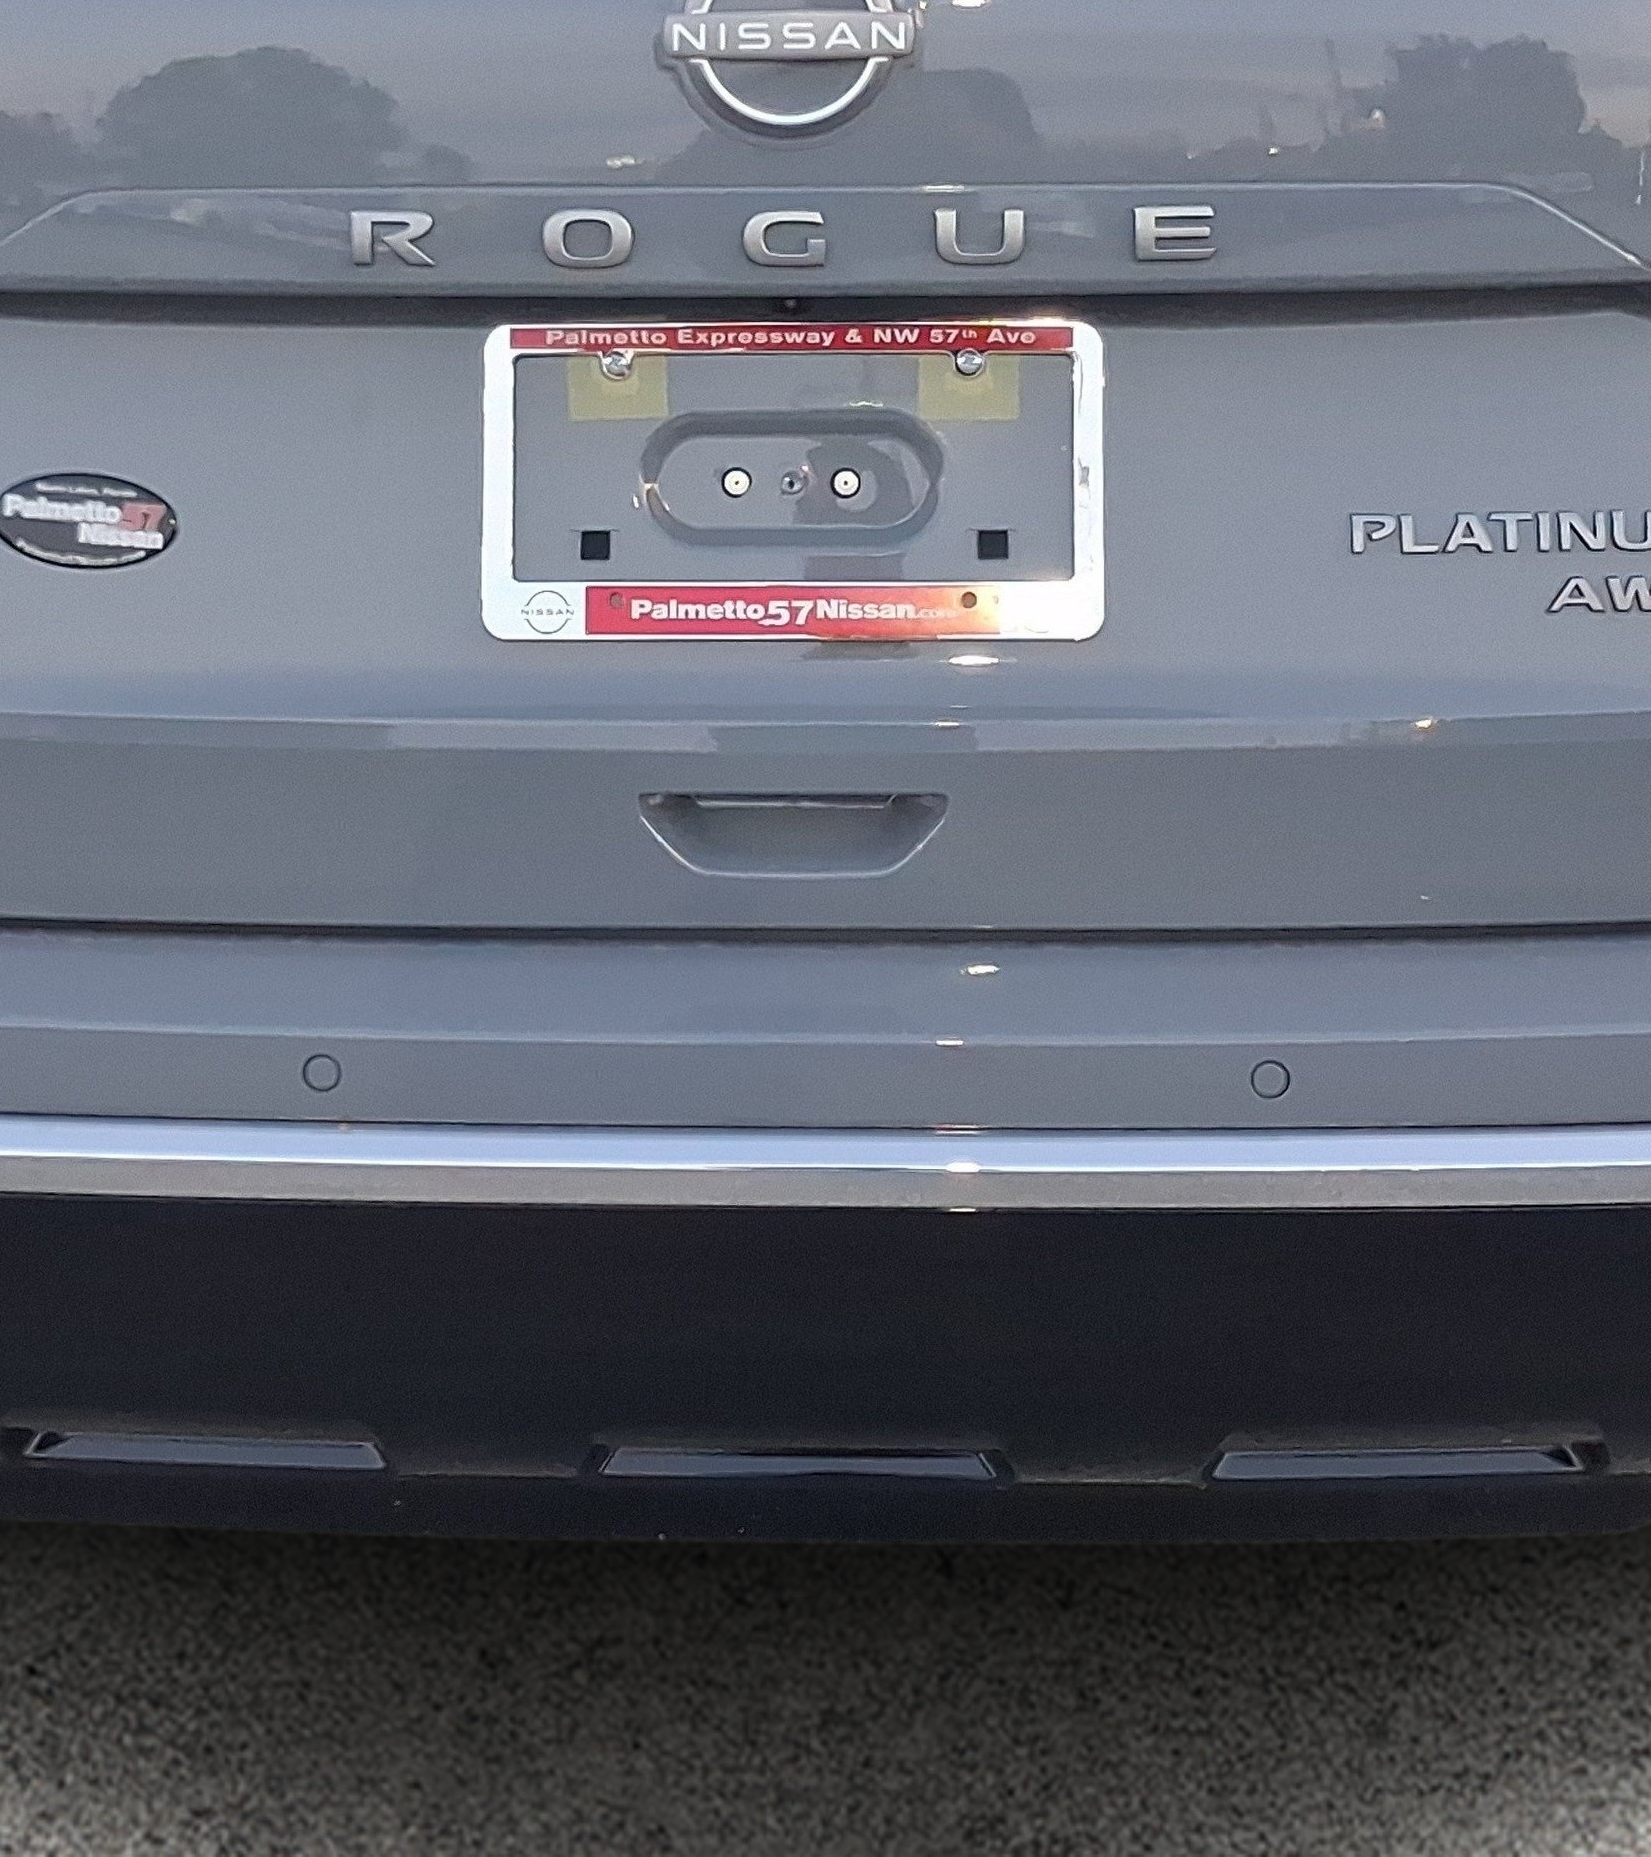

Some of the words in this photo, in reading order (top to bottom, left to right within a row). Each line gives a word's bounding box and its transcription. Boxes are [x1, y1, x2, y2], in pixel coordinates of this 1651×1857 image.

[671, 21, 906, 51] NISSAN
[351, 204, 1219, 269] ROGUE
[545, 329, 667, 345] Palmetto
[677, 328, 835, 347] Expressway
[844, 328, 863, 344] &
[873, 328, 921, 344] NW
[929, 328, 978, 344] 57th
[520, 606, 575, 617] NISSAN
